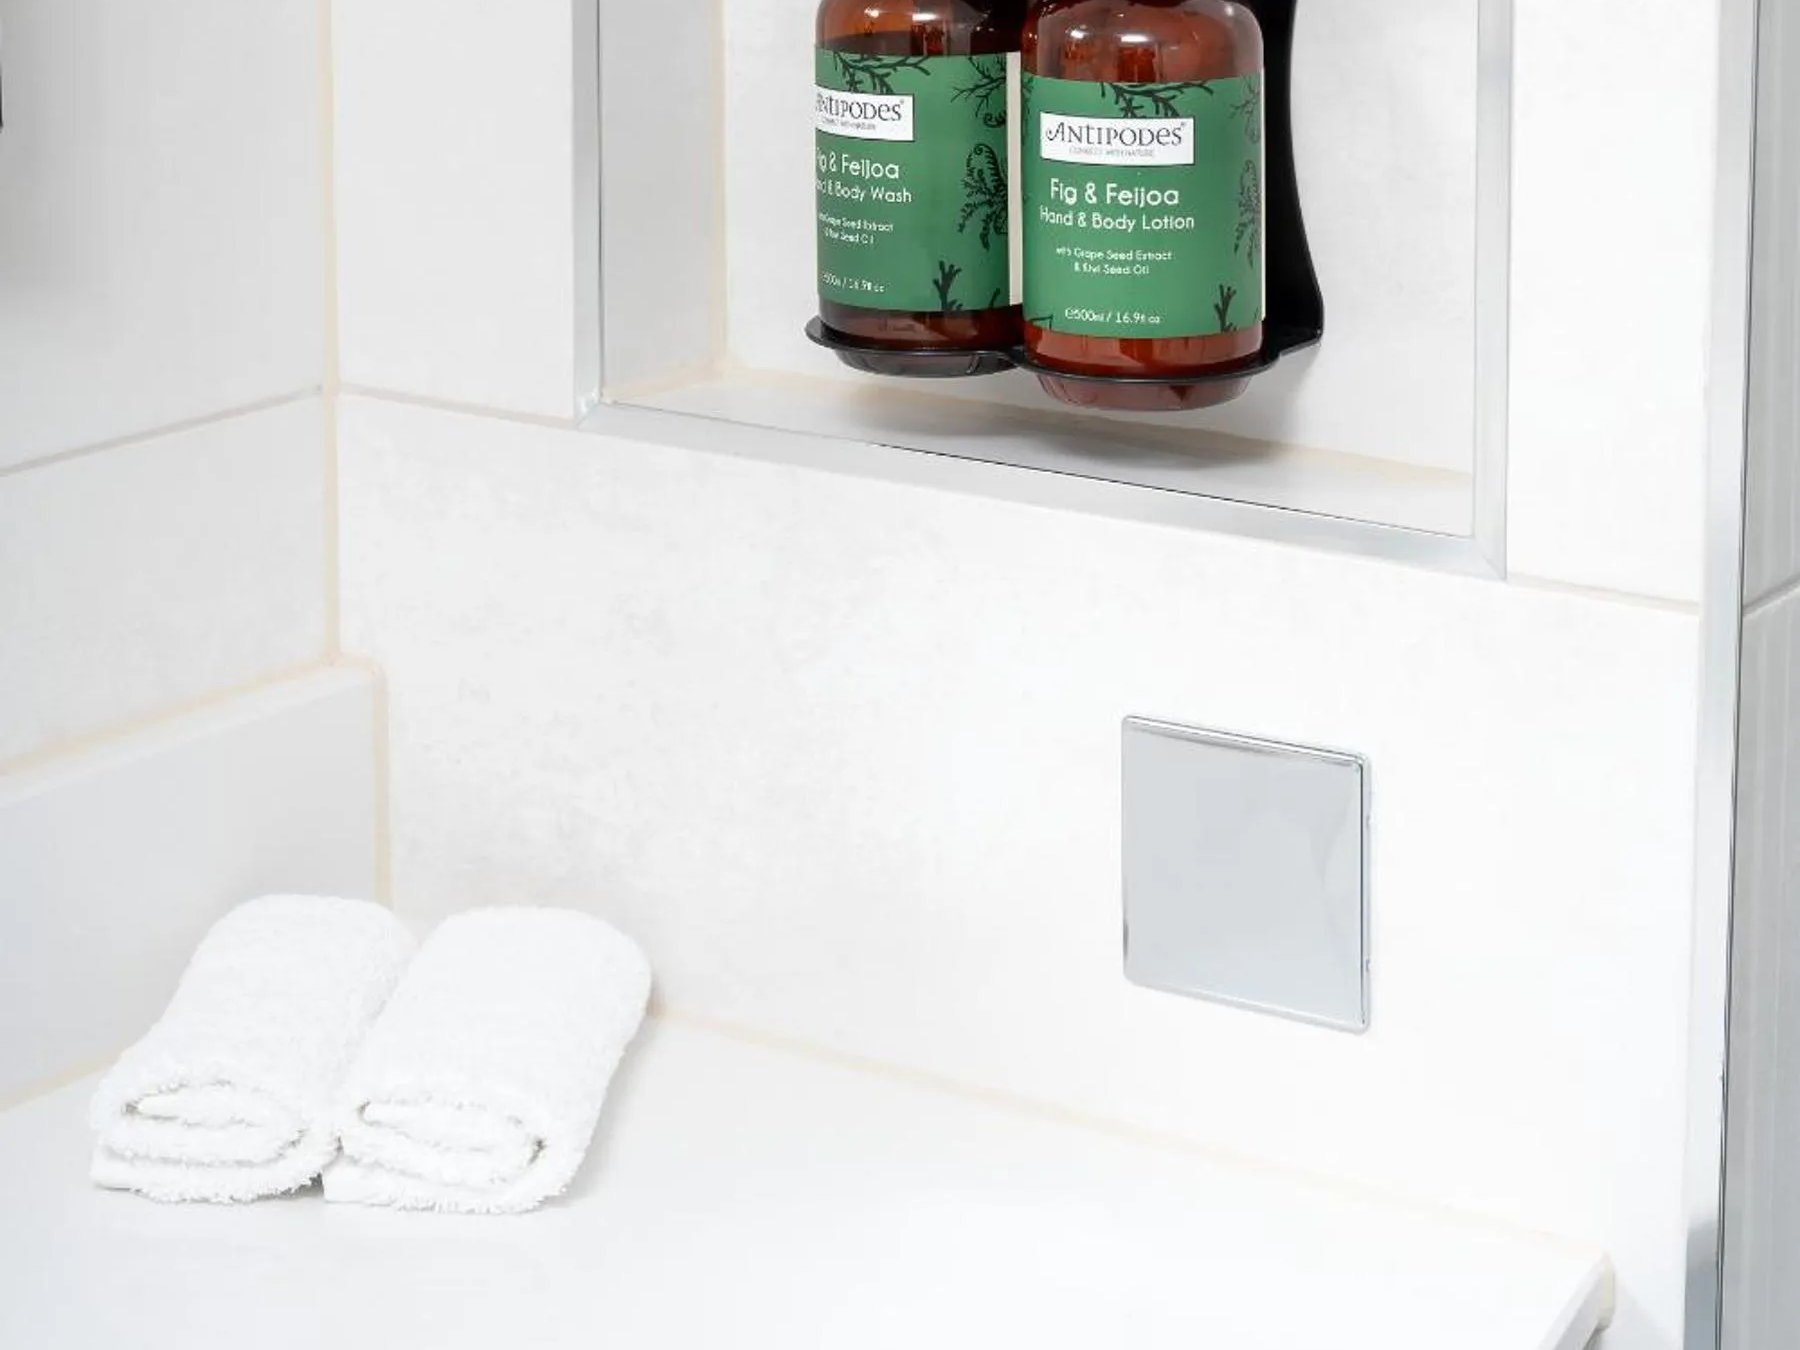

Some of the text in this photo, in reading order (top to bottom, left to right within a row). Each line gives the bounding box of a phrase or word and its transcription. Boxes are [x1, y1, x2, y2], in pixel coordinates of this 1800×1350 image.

[829, 151, 836, 172] &
[841, 153, 900, 179] Feijoa
[835, 181, 864, 202] Body
[870, 186, 912, 203] Wash
[1050, 177, 1179, 208] Fig & Feijoa
[1039, 205, 1195, 233] Hand & Body Lotion
[1074, 248, 1104, 261] Grape
[1106, 250, 1133, 260] Seed
[1135, 250, 1172, 260] Extract
[1103, 264, 1131, 274] Seed
[1132, 264, 1149, 274] Oil
